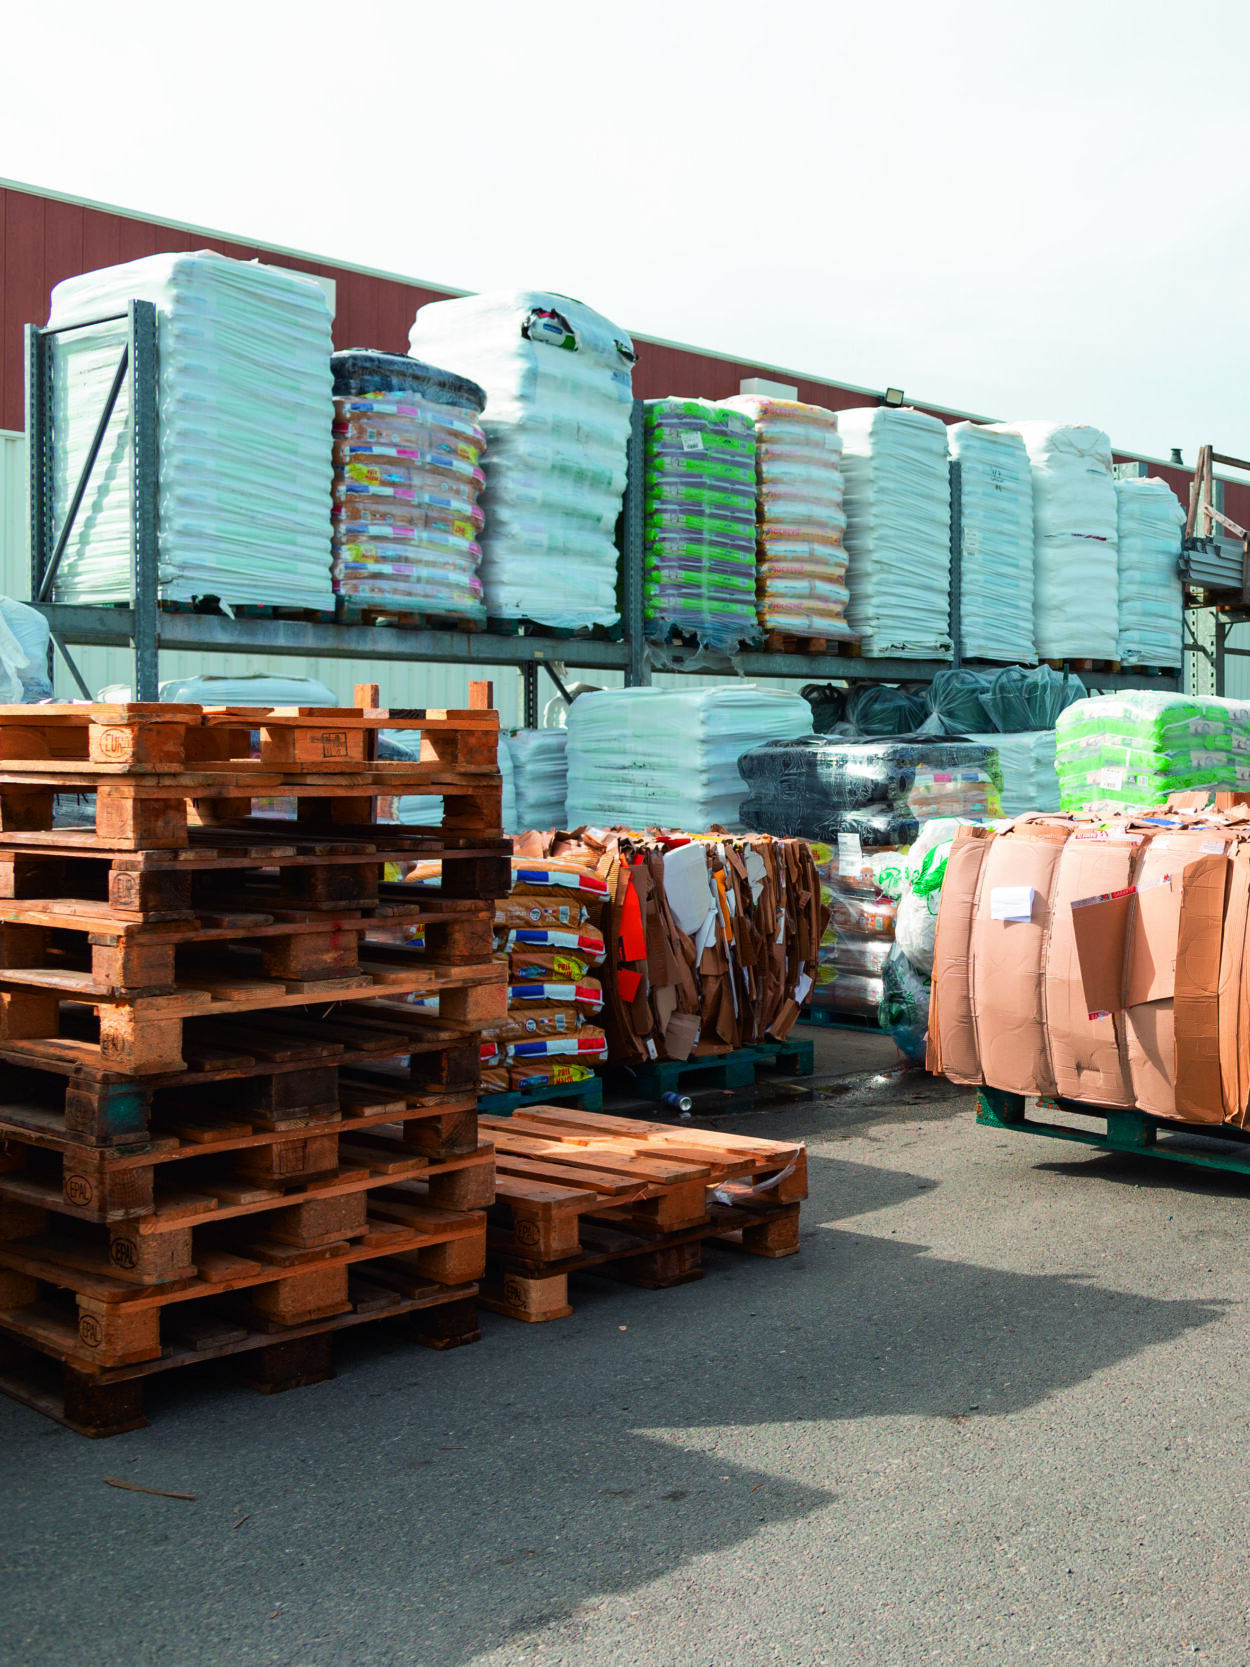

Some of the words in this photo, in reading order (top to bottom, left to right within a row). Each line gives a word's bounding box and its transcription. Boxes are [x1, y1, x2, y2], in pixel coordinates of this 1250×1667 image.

[69, 1181, 89, 1200] EPAL
[115, 1242, 135, 1265] EPAL
[81, 1320, 99, 1343] EPAL
